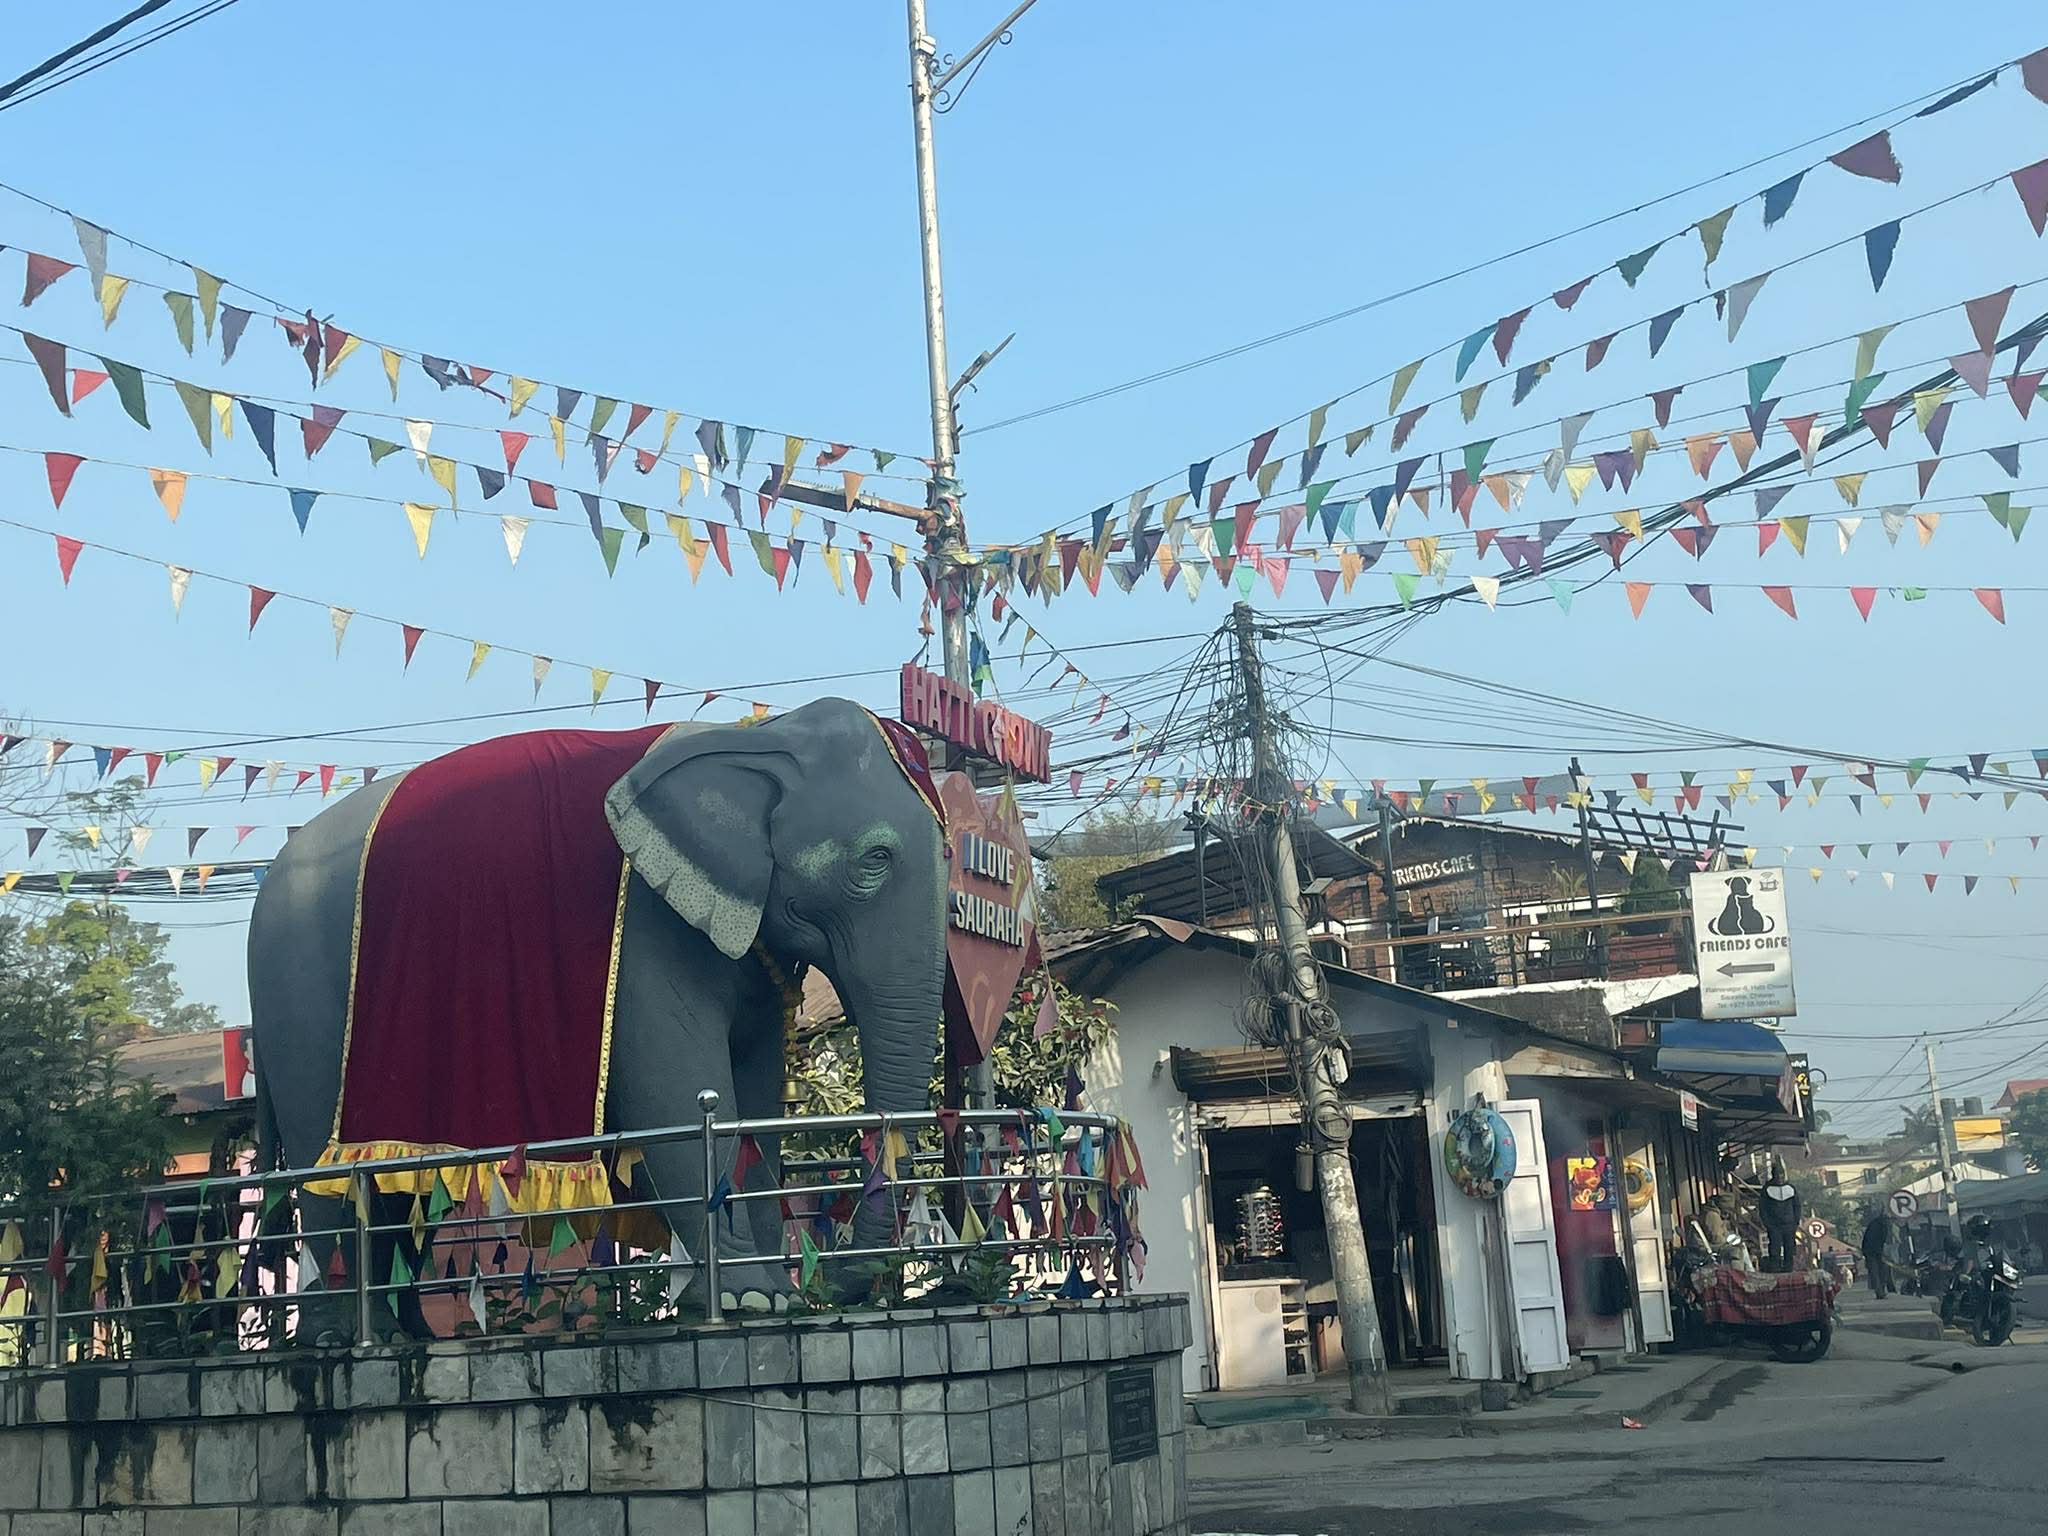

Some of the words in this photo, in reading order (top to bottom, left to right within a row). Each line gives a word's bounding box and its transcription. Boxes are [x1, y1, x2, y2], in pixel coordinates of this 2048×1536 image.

[904, 663, 976, 750] HATTI
[978, 837, 1015, 885] LOVE
[1392, 861, 1441, 885] RIENDS
[1441, 854, 1475, 875] CAFE
[955, 890, 1025, 948] SAURAHA
[1700, 938, 1751, 953] FRIENDS
[1754, 936, 1788, 949] CAFE
